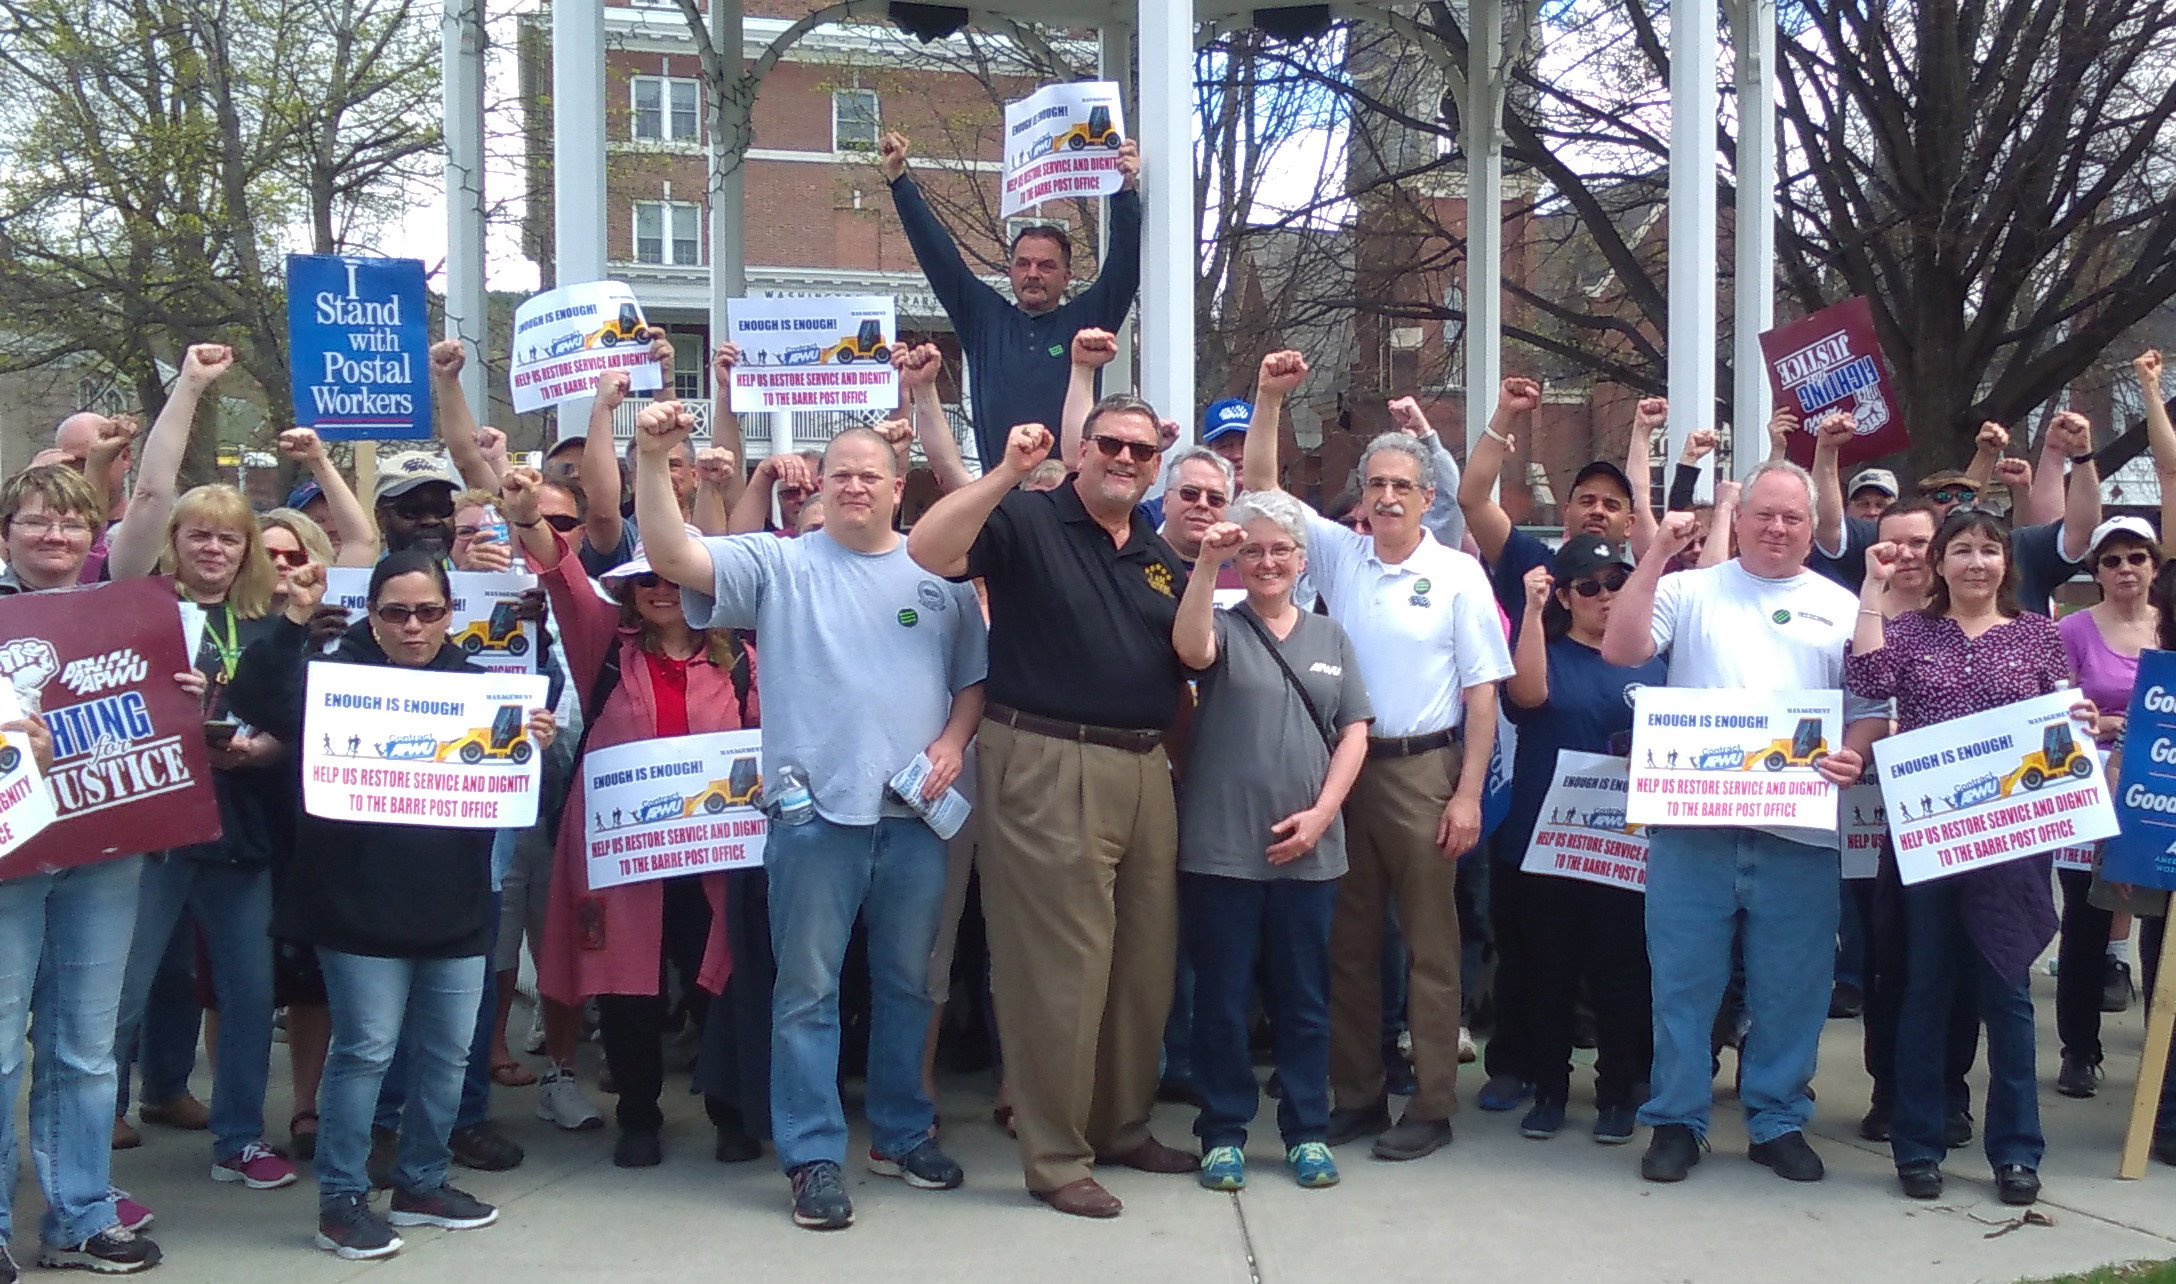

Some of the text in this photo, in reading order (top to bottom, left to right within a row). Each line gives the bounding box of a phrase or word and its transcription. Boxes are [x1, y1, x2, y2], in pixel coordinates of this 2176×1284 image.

[1043, 159, 1071, 177] SERVICE
[1073, 158, 1089, 171] AND
[1091, 157, 1119, 170] DIGNIT
[1053, 178, 1073, 192] POST
[1074, 176, 1100, 190] OFFICE
[345, 265, 360, 299] I
[316, 292, 402, 325] Stand
[545, 311, 554, 322] IS
[555, 304, 597, 319] ENOUGH!
[739, 319, 837, 331] ENOUGH IS ENOUGH!
[348, 327, 400, 352] with
[323, 352, 412, 383] Postal
[788, 349, 819, 364] APWU
[1776, 335, 1848, 386] JUSTICE
[515, 374, 530, 388] HELP
[542, 362, 574, 381] RESTORE
[574, 356, 606, 371] SERVICE
[608, 355, 620, 367] AND
[737, 372, 891, 387] HELP US RESTORE SERVICE AND DIGNITY
[540, 376, 599, 400] TO THE BARRE PO
[1796, 355, 1880, 413] FIGHTING
[310, 386, 413, 414] Workers
[764, 391, 867, 406] TO THE BARRE POST OFFICE
[325, 693, 464, 716] ENOUGH IS ENOUGH!
[1648, 714, 1769, 729] ENOUGH IS ENOUGH!
[389, 733, 433, 742] Contract
[86, 734, 131, 766] for
[1702, 745, 1741, 755] Contract
[1703, 752, 1742, 768] APWU
[1891, 734, 2014, 779] ENOUGH IS ENOUGH!
[313, 765, 530, 793] HELP US RESTORE SERVICE AND DIGNITY
[593, 761, 703, 789] ENOUGH IS ENOUGH!
[1562, 776, 1599, 789] ENOUGH
[1599, 778, 1610, 789] IS
[1637, 778, 1829, 796] HELP US RESTORE SERVICE AND DIGNITY
[1953, 772, 1994, 793] Contract
[642, 792, 680, 807] Contract
[1960, 780, 1998, 807] APWU
[349, 794, 498, 818] TO THE BARRE POST OFFICE
[646, 799, 682, 820] APWU
[1667, 801, 1796, 817] TO THE BARRE POST OFFICE
[1899, 787, 2100, 851] HELP US RESTORE SERVICE AND DIGNITY
[592, 819, 766, 858] HELP US RESTORE SERVICE AND DIGNIT
[1536, 831, 1555, 845] HELP
[1555, 832, 1566, 847] US
[1567, 834, 1604, 853] RESTORE
[1604, 839, 1640, 859] SERVICE
[1847, 834, 1869, 849] HELP
[1937, 819, 2075, 867] TO THE BARRE POST OFFICE
[619, 844, 745, 876] TO THE BARRE POST OFFICE
[1555, 853, 1565, 869] TO
[1566, 854, 1582, 871] THE
[1582, 857, 1611, 876] BARRE
[1612, 862, 1637, 881] POST
